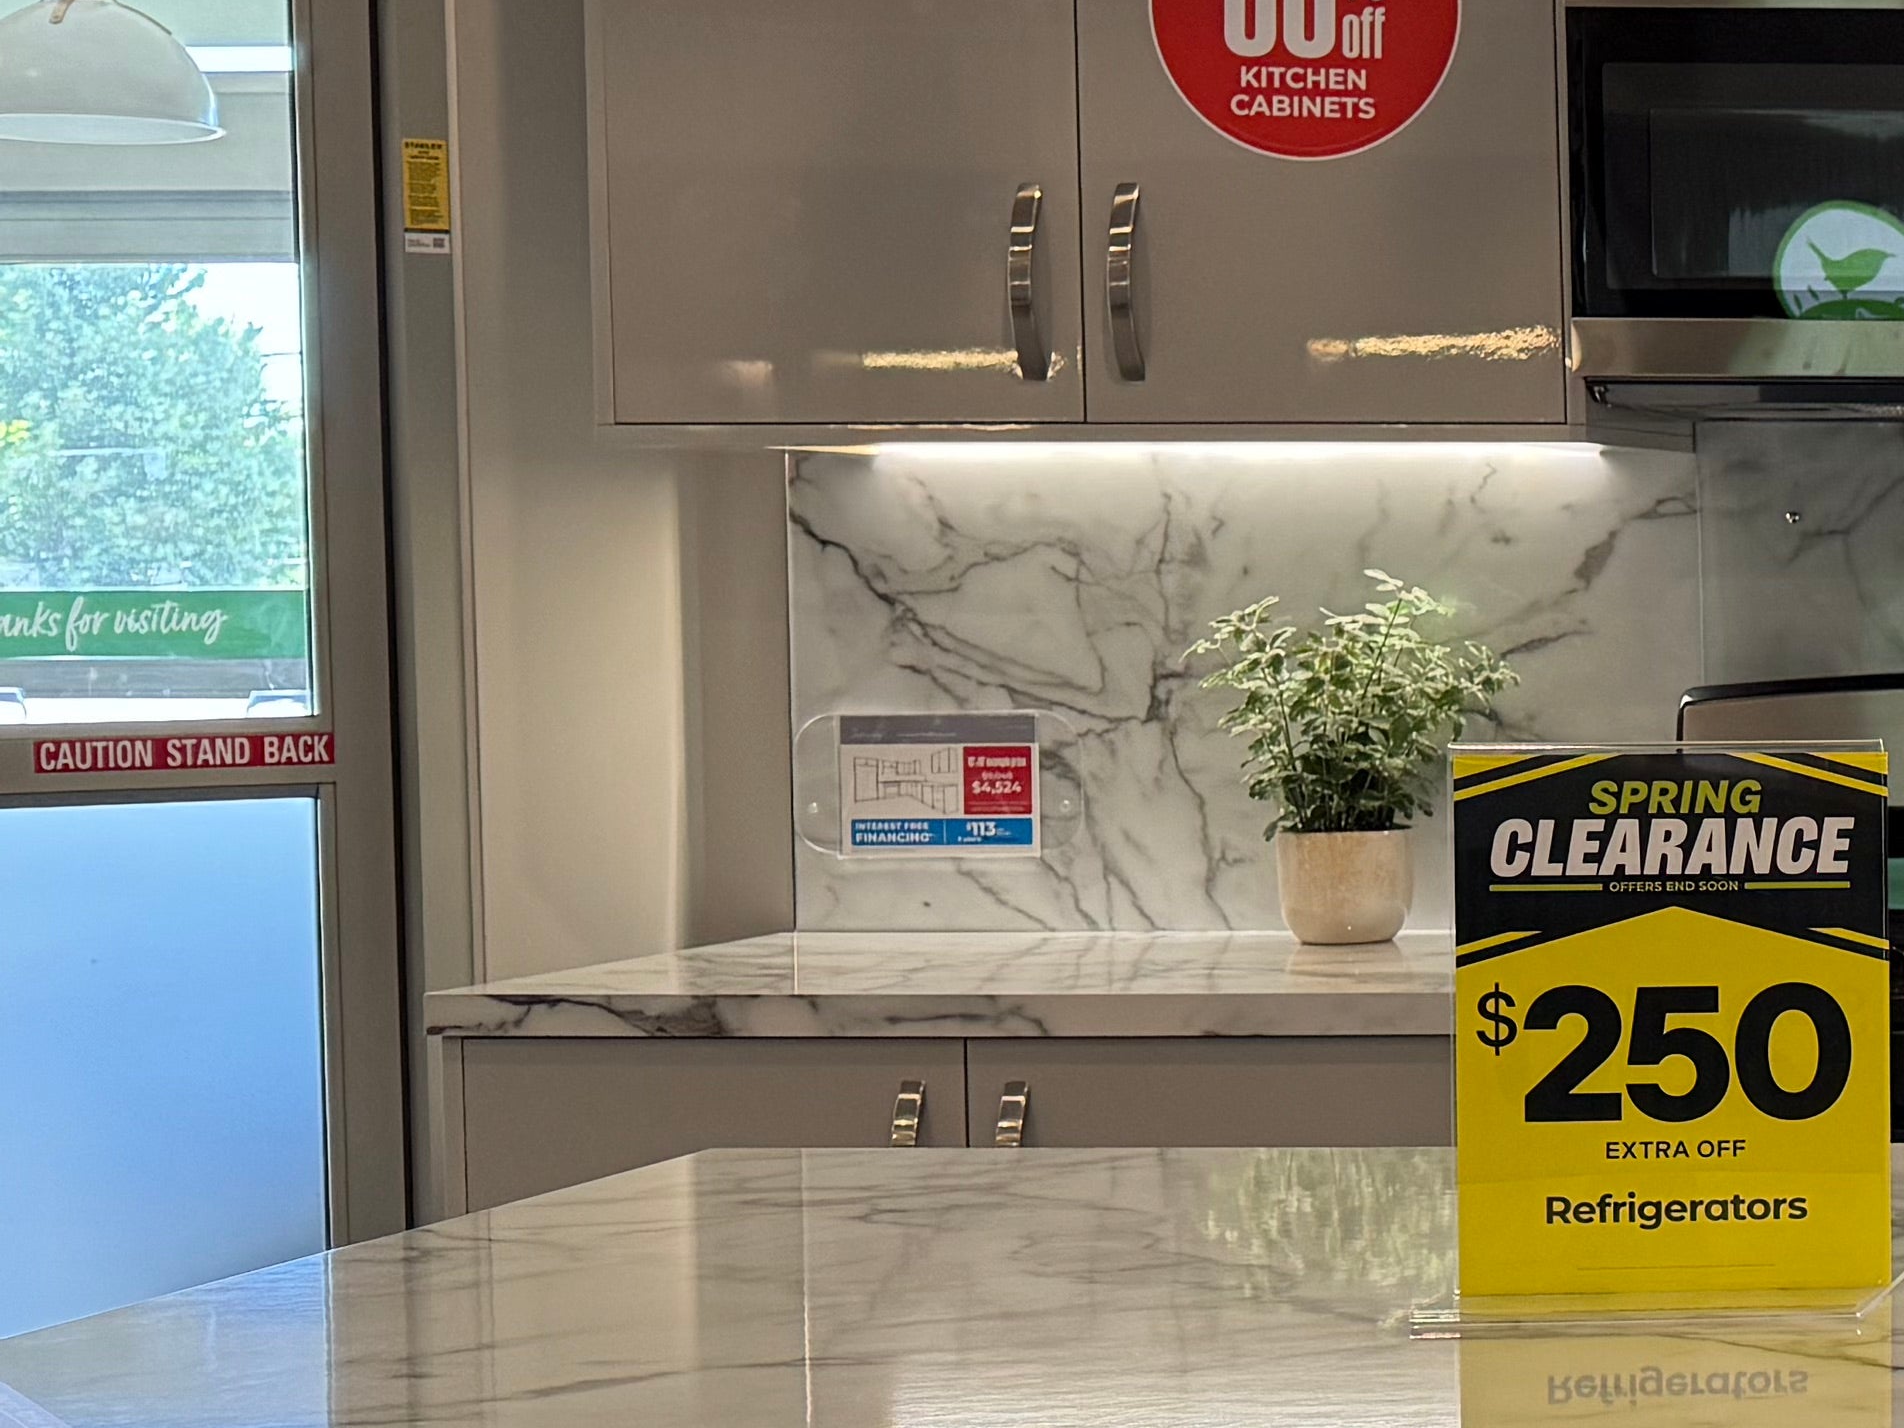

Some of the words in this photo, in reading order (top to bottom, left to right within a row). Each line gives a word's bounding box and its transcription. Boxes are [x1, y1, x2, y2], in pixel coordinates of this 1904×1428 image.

[1342, 6, 1386, 59] off
[1240, 65, 1367, 91] KITCHEN
[1230, 94, 1376, 119] CABINETS
[65, 596, 110, 652] for
[113, 599, 229, 645] visiting
[39, 739, 153, 771] CAUTION
[166, 736, 251, 768] STAND
[263, 734, 330, 764] BACK
[1588, 778, 1762, 815] SPRING
[855, 821, 902, 830] INTEREST
[1489, 816, 1856, 878] CLEARANCE
[1609, 881, 1662, 892] OFFERS
[1666, 881, 1695, 892] END
[1698, 880, 1739, 891] SOON
[1477, 981, 1852, 1123] $250
[1605, 1140, 1690, 1160] EXTRA
[1696, 1139, 1747, 1159] OFF
[1546, 1190, 1808, 1230] Refrigerators
